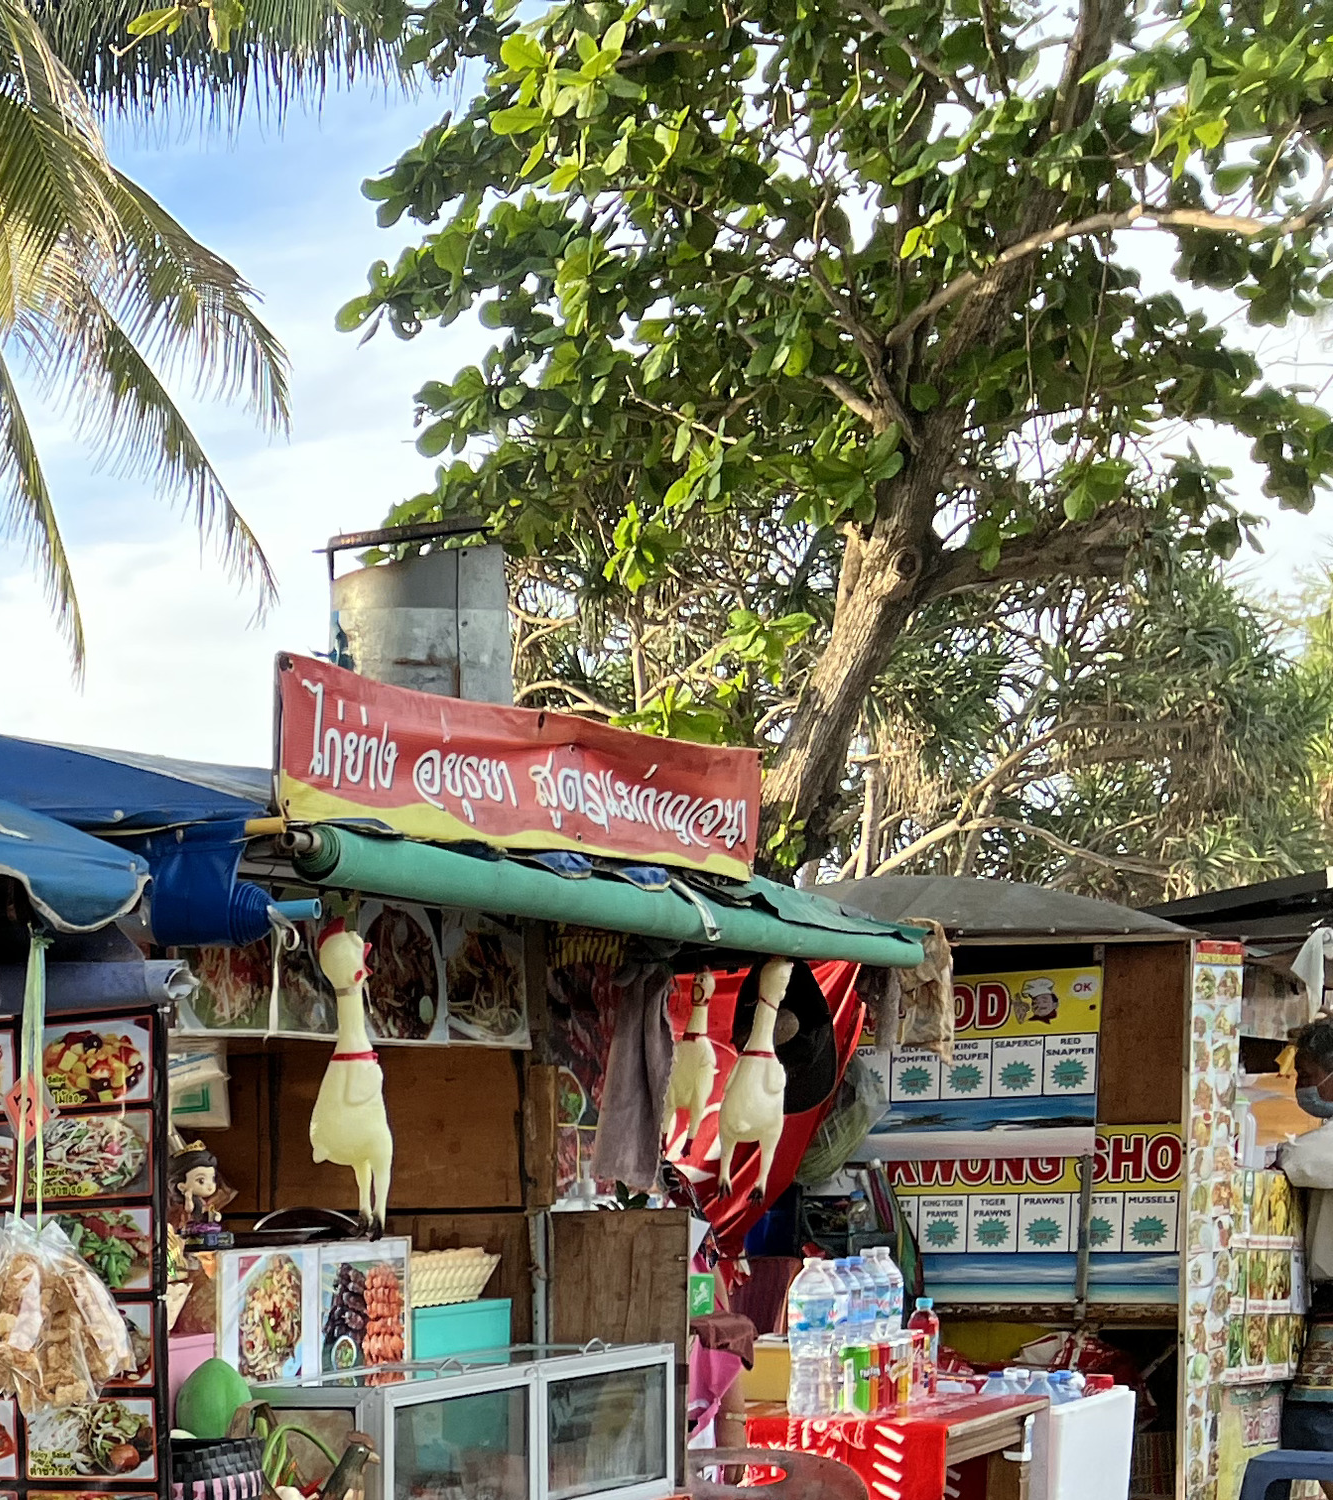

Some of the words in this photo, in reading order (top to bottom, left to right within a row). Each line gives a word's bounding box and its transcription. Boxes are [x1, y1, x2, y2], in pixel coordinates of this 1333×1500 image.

[301, 679, 399, 790] ไก่ย่าง
[413, 748, 518, 823] อยุธยา
[529, 750, 747, 849] สูตรแม่กาญจนา
[1073, 982, 1093, 993] OK
[995, 1039, 1042, 1049] SEAPERCH
[1060, 1037, 1081, 1045] RED
[954, 1042, 979, 1050] KING
[1046, 1047, 1095, 1056] SNAPPER
[893, 1055, 938, 1063] POMFRET
[952, 1052, 989, 1061] ROUPER
[943, 1199, 963, 1207] TIGER
[980, 1198, 1006, 1206] TIGER
[1024, 1197, 1065, 1205] PRAWNS
[1129, 1196, 1176, 1205] MUSSELS
[926, 1210, 959, 1218] PRAWNS
[974, 1209, 1012, 1217] PRAWNS
[52, 1450, 71, 1459] Salad
